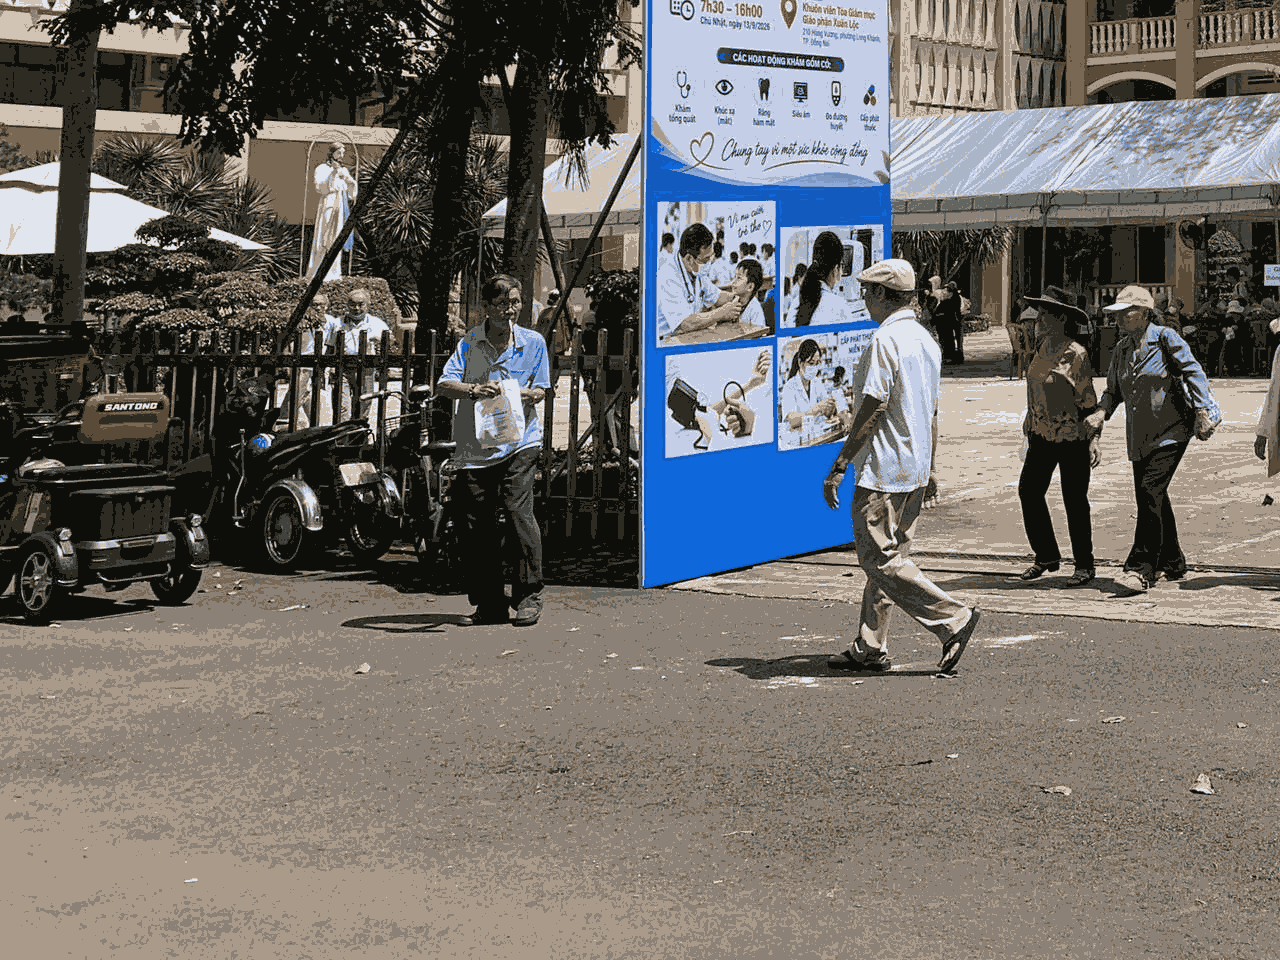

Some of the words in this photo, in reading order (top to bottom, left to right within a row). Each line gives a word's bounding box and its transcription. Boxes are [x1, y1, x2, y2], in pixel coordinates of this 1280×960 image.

[700, 0, 724, 15] 7h30
[735, 3, 763, 19] 16h00
[732, 51, 748, 63] CÁC
[767, 54, 786, 67] ĐỘNG
[786, 56, 805, 67] KHÁM
[721, 138, 753, 166] Chung
[755, 141, 769, 166] tay
